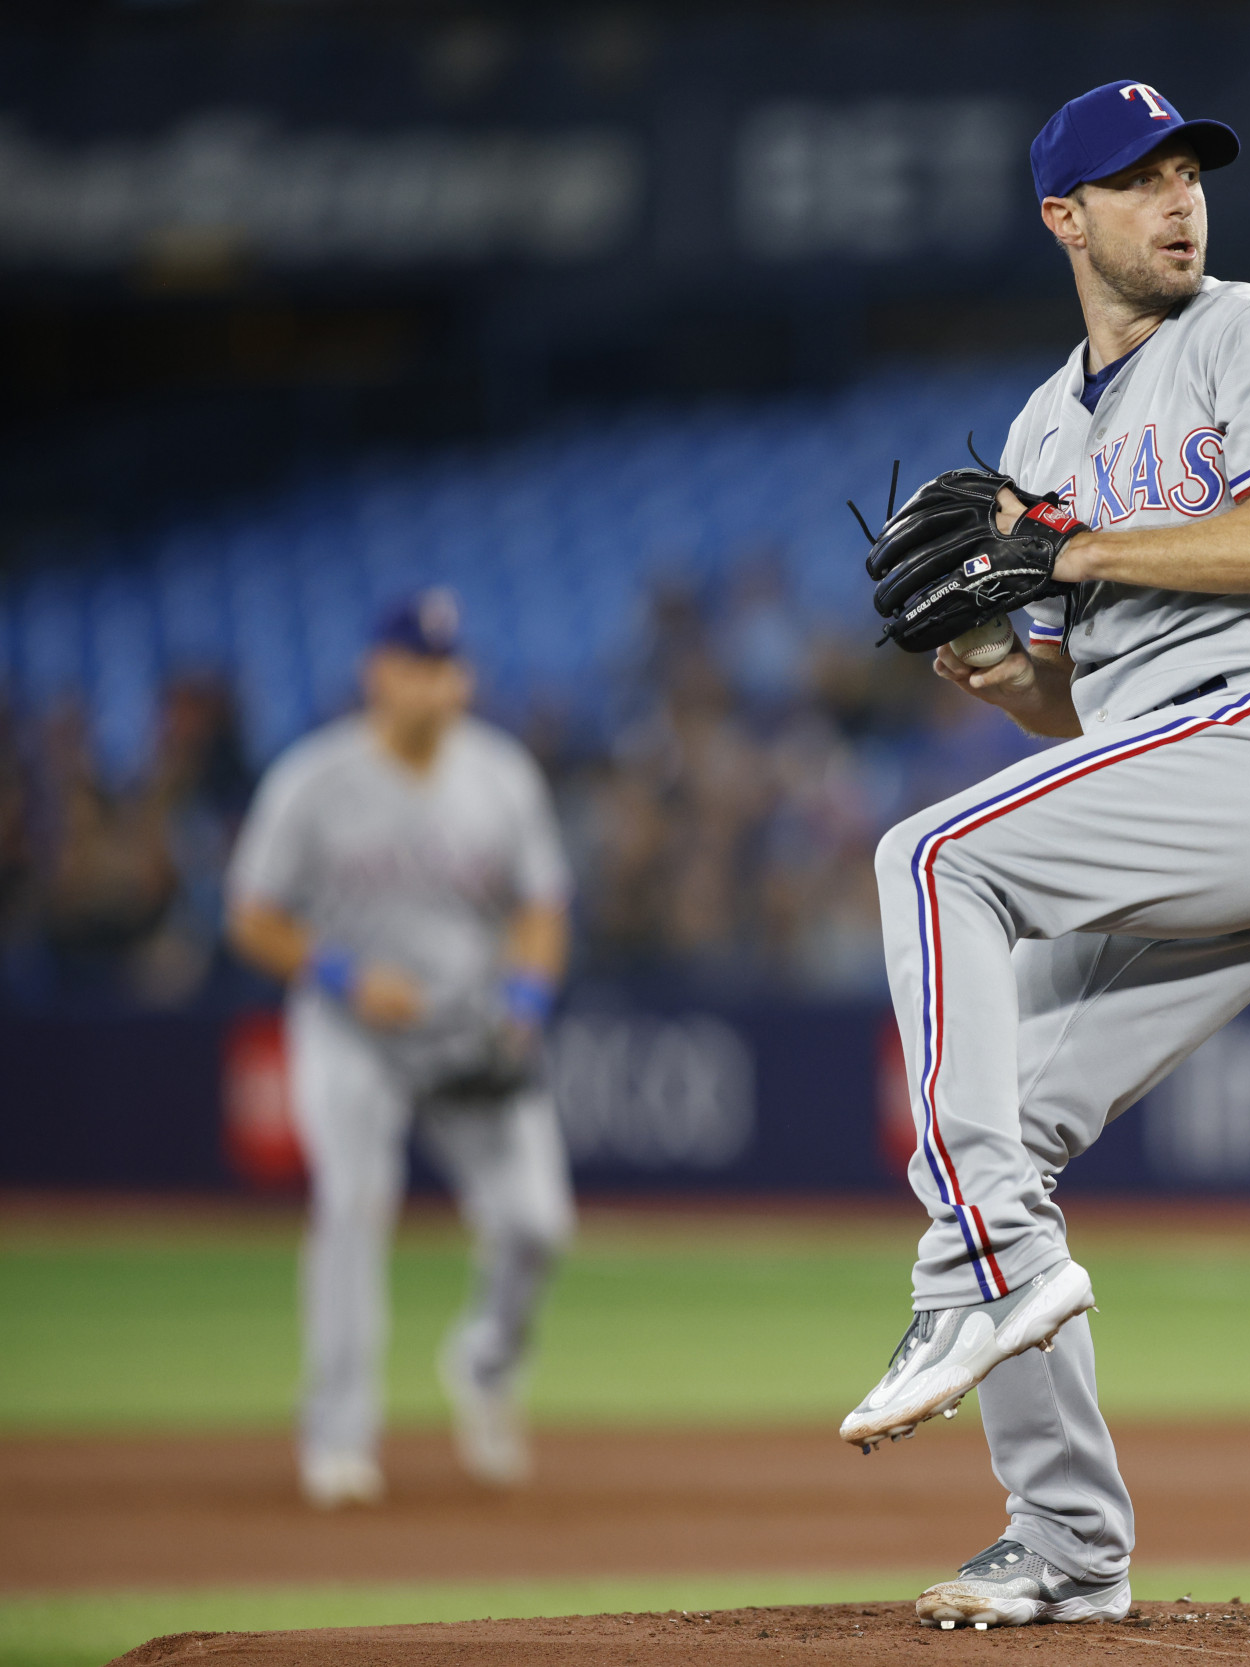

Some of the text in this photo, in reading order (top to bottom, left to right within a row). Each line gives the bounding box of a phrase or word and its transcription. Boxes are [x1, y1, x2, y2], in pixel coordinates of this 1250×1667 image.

[1119, 83, 1171, 120] T
[1056, 424, 1227, 531] XAS
[905, 581, 961, 621] THE GOLD GLOVE CO.
